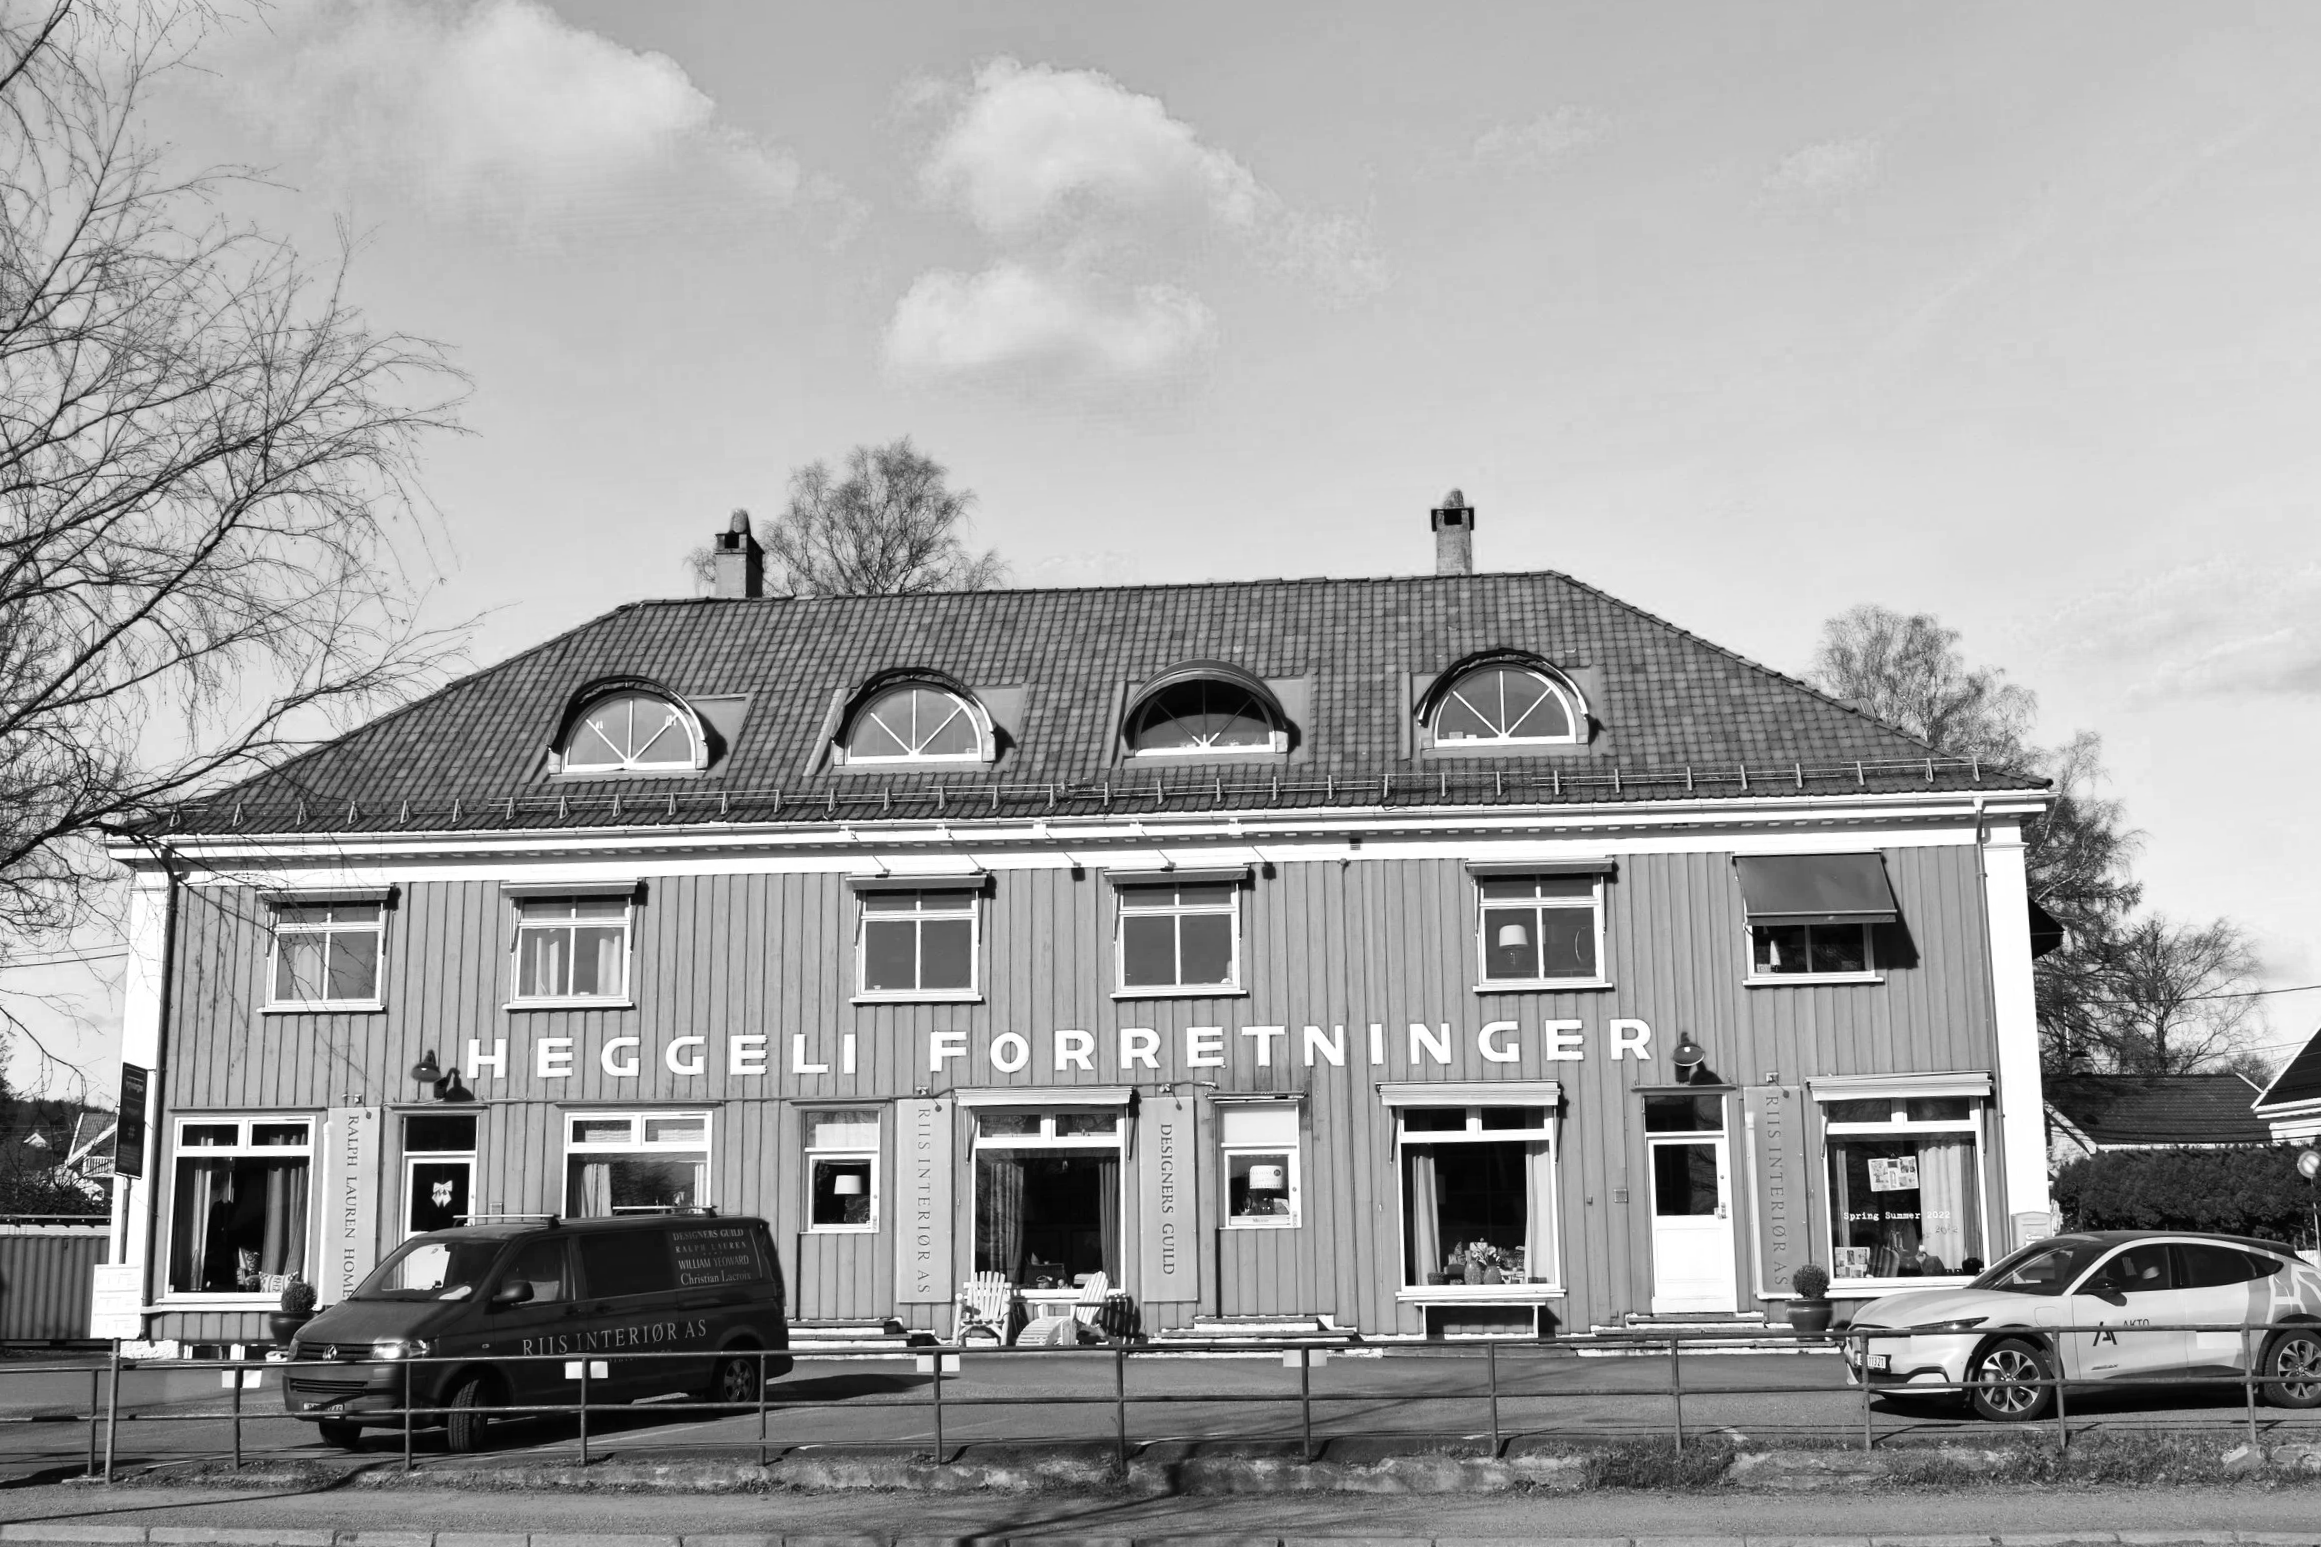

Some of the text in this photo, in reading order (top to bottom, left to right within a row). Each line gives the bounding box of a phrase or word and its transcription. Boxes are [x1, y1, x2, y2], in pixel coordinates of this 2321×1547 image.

[466, 1018, 1652, 1079] HEGGELI FORRETNINGER
[342, 1115, 360, 1298] RALPH LAUREN HOME
[917, 1108, 931, 1293] RIIS INTERIØR AS
[1160, 1123, 1175, 1275] DESIGNERS GUILD
[1765, 1096, 1789, 1285] RIIS INTERIØR AS
[672, 1228, 744, 1241] DESIGNERS GUILD
[1843, 1210, 1951, 1222] Spring Summer 2022
[678, 1258, 711, 1270] WILLIAM
[680, 1270, 752, 1286] Christian Lacroix
[522, 1319, 707, 1356] RIIS INTERIØR AS
